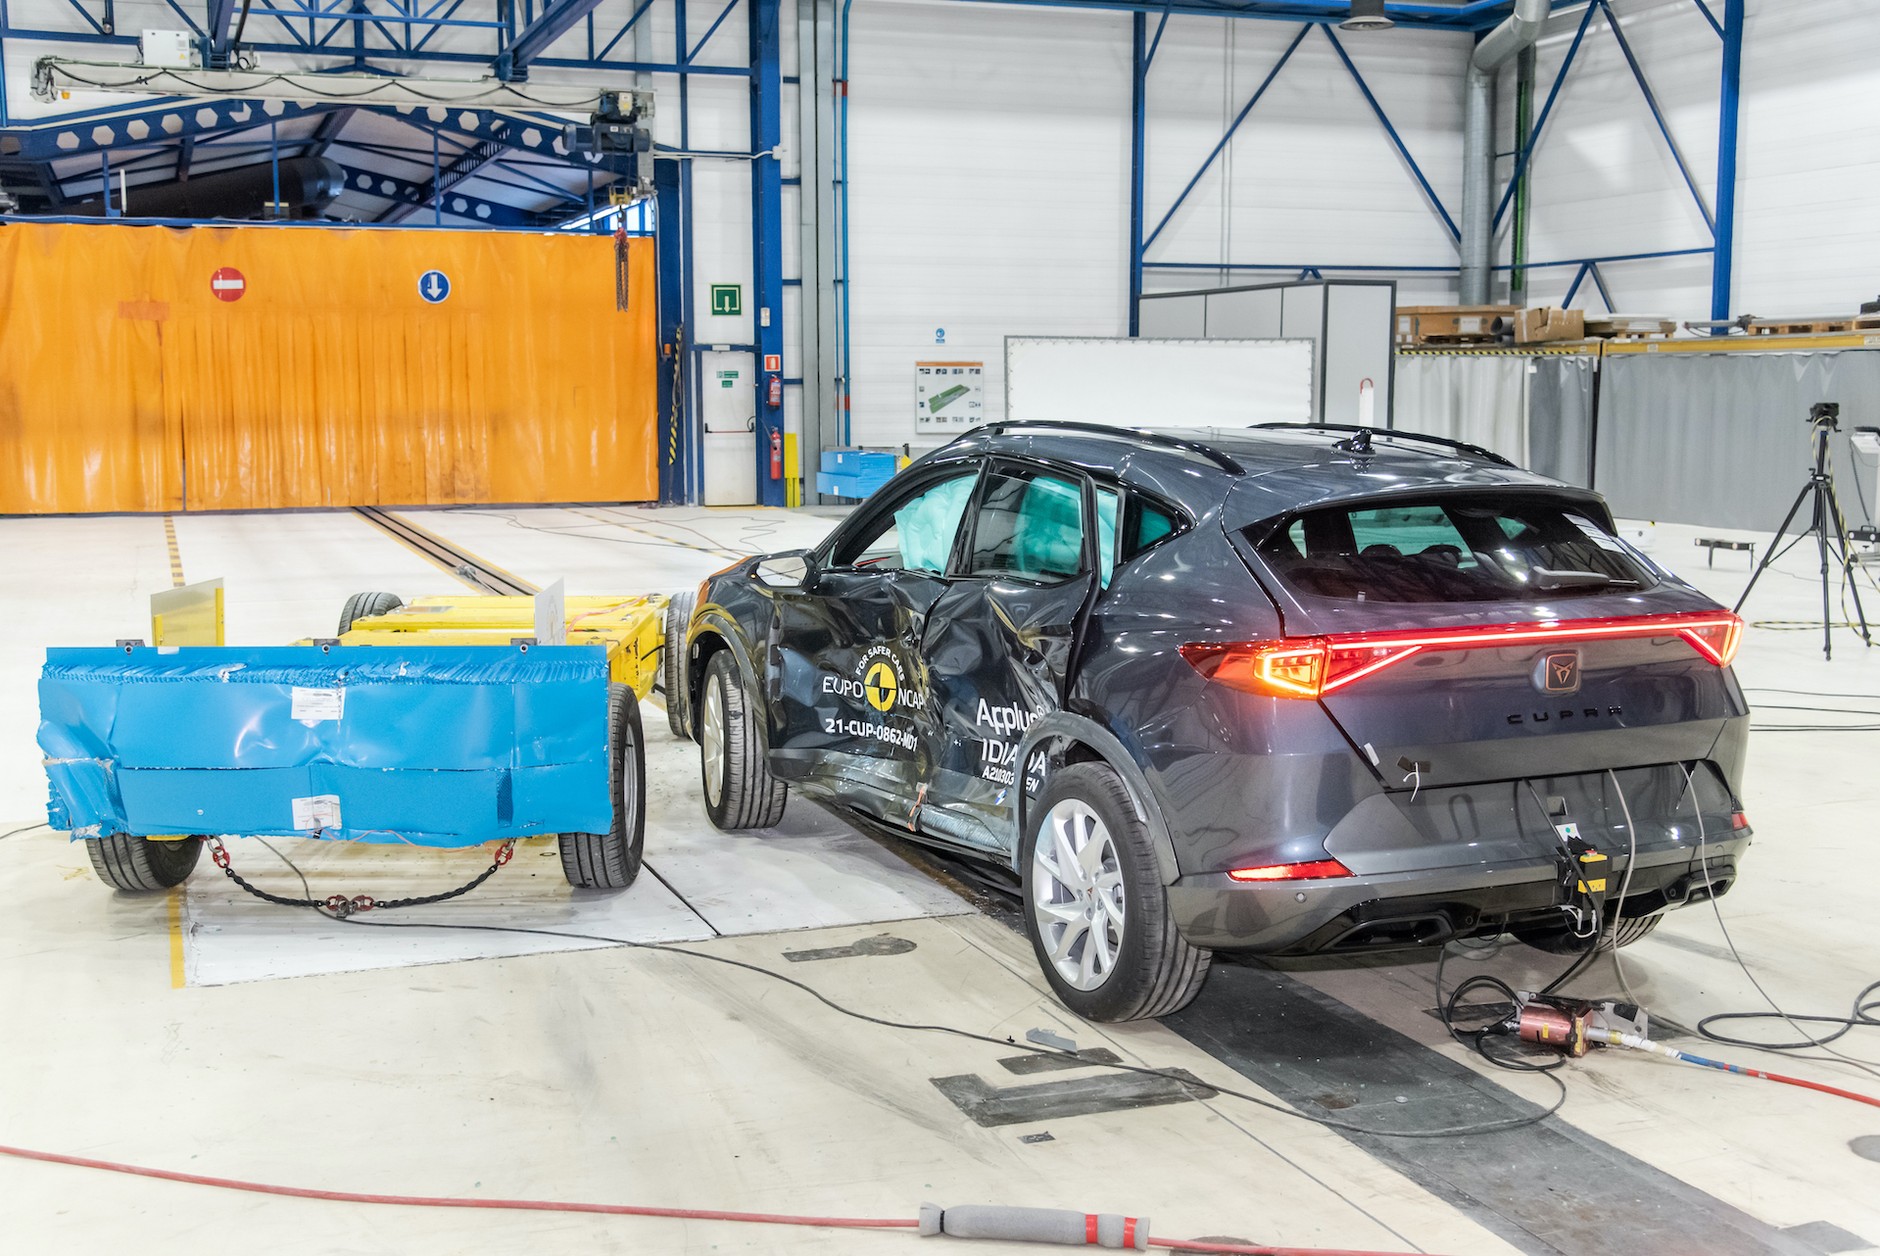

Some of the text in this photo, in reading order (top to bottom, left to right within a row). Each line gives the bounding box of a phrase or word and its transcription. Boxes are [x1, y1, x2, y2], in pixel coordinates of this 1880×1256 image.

[855, 645, 905, 682] FOR SAFER CARS
[897, 688, 925, 710] NCAP
[1506, 705, 1622, 725] CUPRA
[981, 738, 1046, 777] IDIAA
